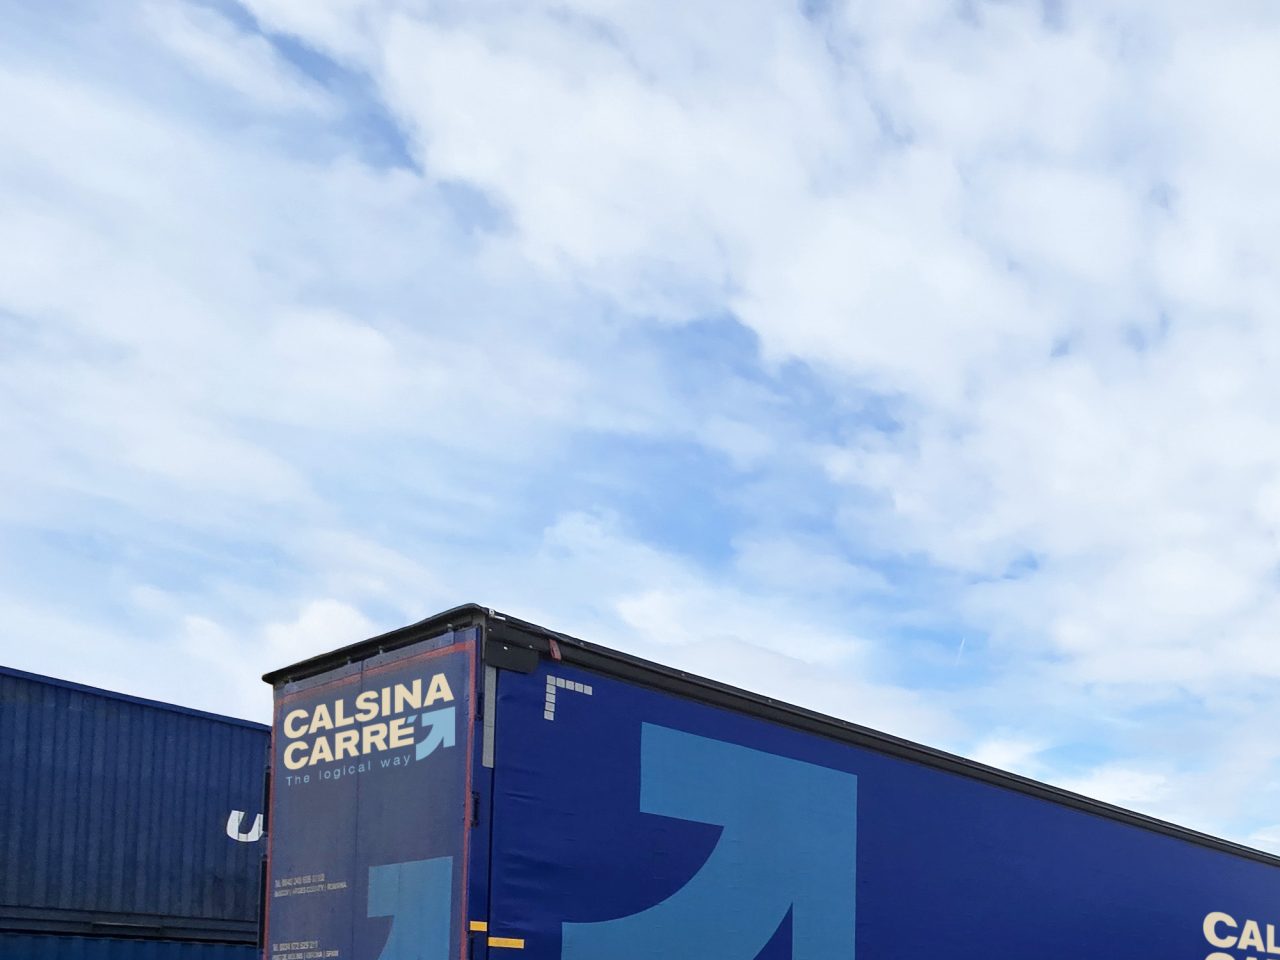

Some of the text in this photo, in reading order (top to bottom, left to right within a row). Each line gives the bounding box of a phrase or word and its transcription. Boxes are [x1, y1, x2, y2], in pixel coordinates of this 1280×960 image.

[284, 673, 454, 739] CALSINA
[285, 754, 411, 787] The logical way
